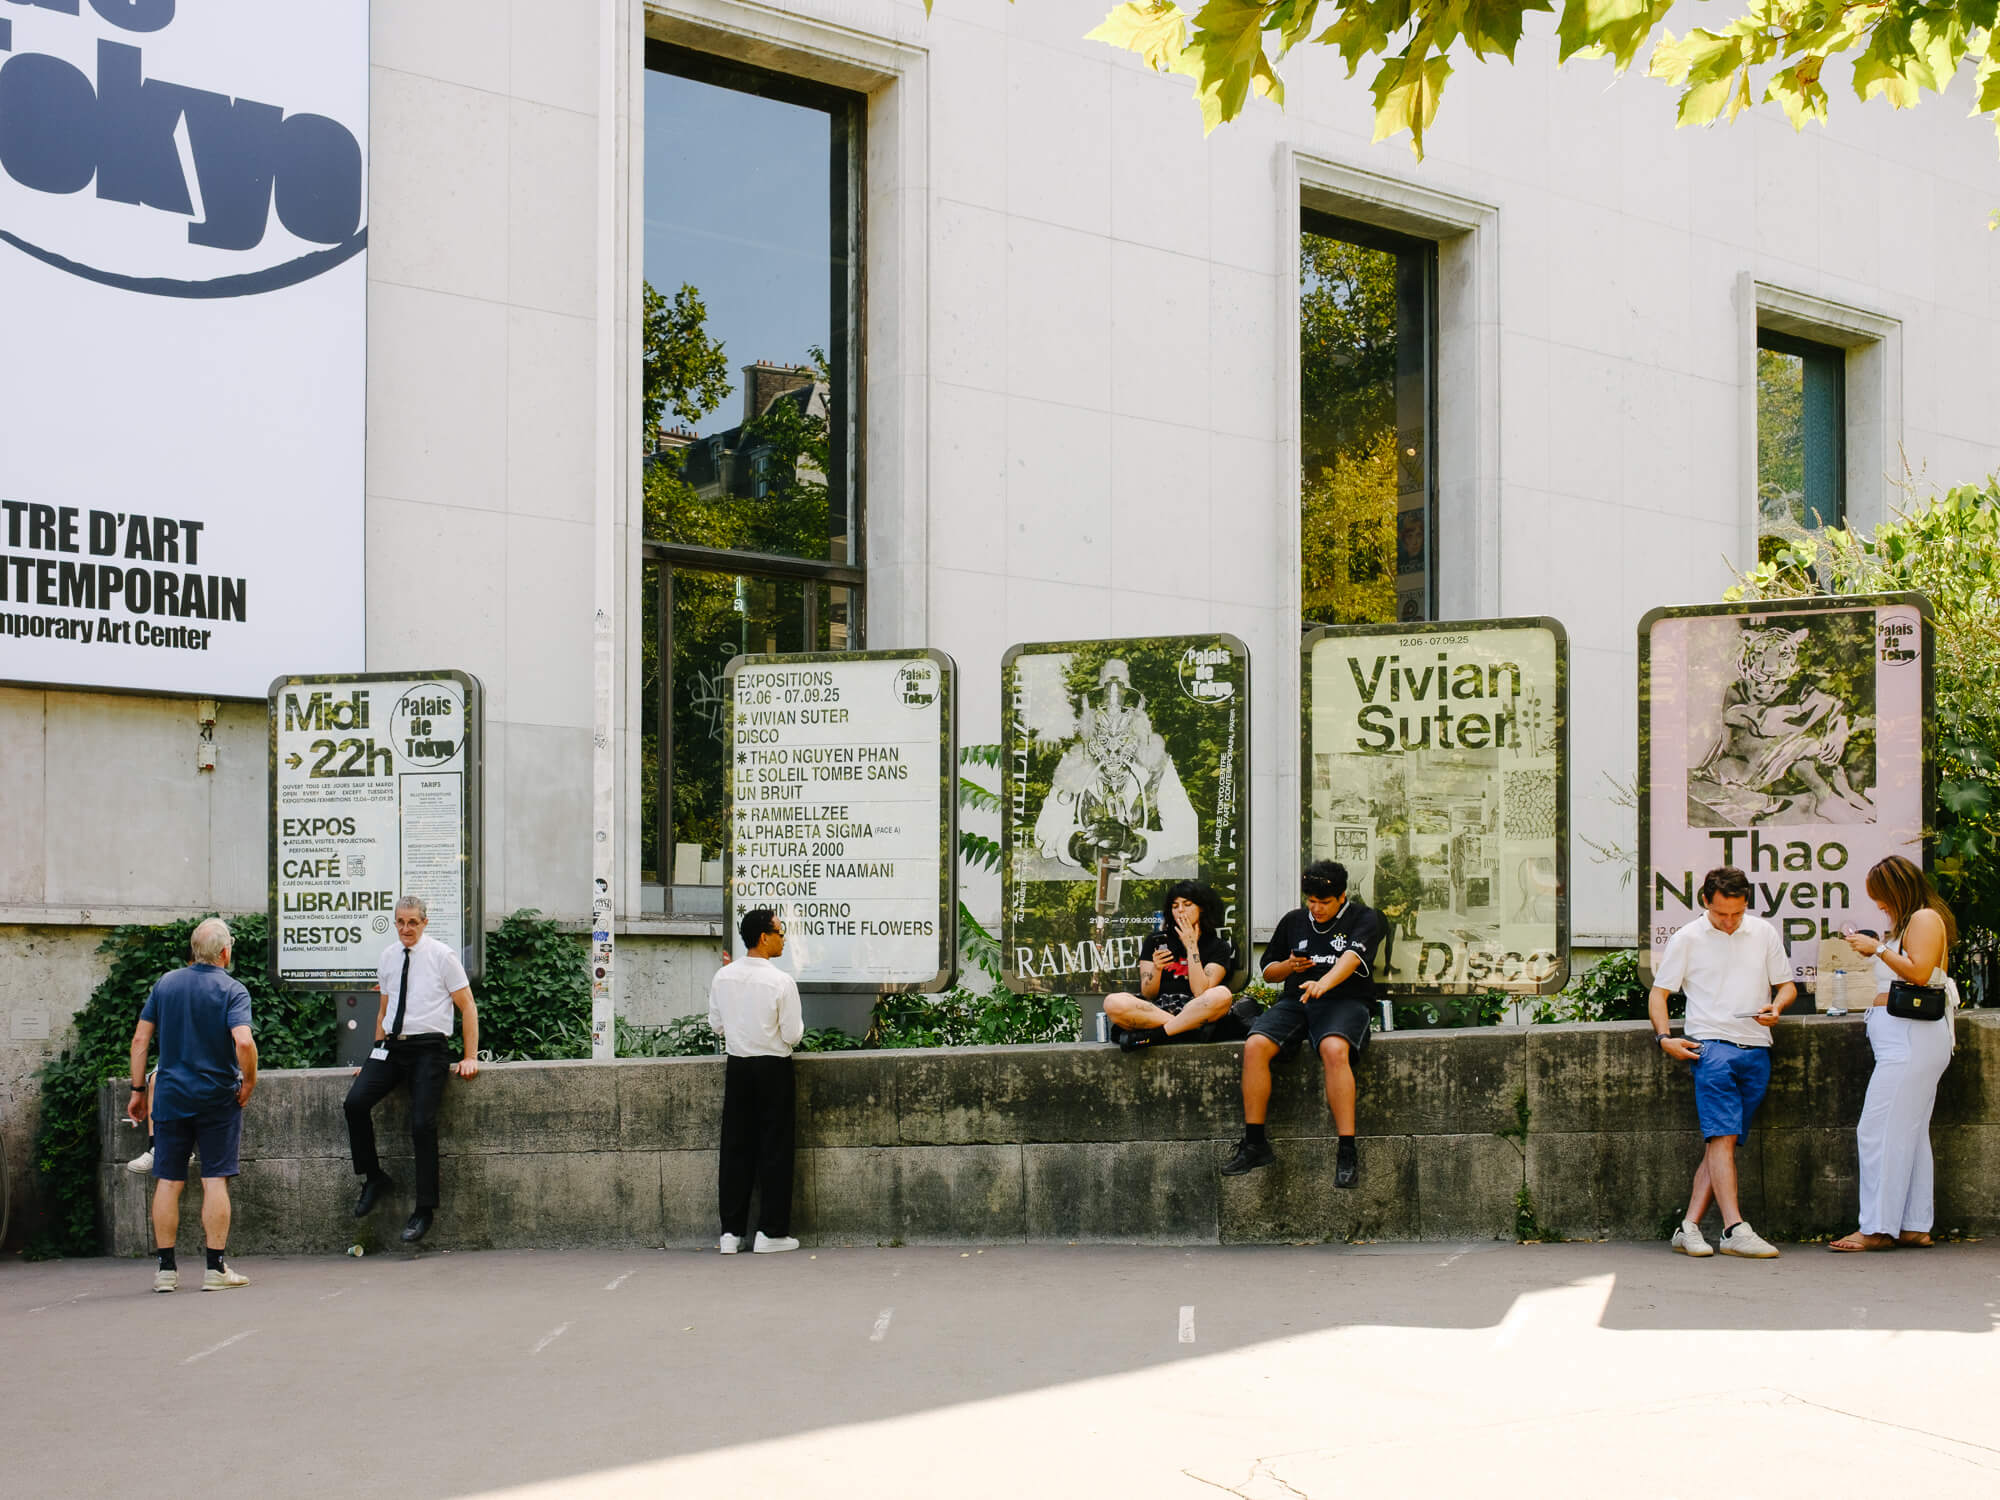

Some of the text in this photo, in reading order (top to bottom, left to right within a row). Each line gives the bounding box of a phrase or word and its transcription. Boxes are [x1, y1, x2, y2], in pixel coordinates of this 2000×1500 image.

[0, 17, 362, 251] okyo
[1, 499, 204, 565] TRE D'ART
[97, 617, 131, 644] Art
[135, 620, 211, 650] Center
[1878, 623, 1914, 637] Palais
[1400, 638, 1422, 647] 12.06
[1430, 636, 1469, 646] 07.09.25
[1884, 636, 1900, 648] de
[1188, 648, 1231, 666] Palais
[1880, 649, 1916, 662] Tokyo
[737, 671, 833, 689] EXPOSITIONS
[899, 668, 931, 681] Palais
[1195, 664, 1214, 681] de
[1347, 653, 1521, 703] Vivian
[905, 681, 919, 692] de
[1191, 680, 1233, 697] Tokyo
[738, 690, 772, 705] 12.06
[784, 688, 840, 703] 07.09.25
[902, 692, 933, 705] Tokyo
[285, 690, 370, 732] Midi
[401, 696, 451, 717] Palais
[751, 708, 849, 726] VIVIAN SUTER
[410, 717, 432, 736] de
[1356, 705, 1515, 752] Suter
[737, 729, 779, 744] DISCO
[405, 738, 455, 759] Tokyo
[751, 747, 899, 765] THAO NGUYEN PHAN
[309, 738, 393, 779] 22h
[737, 765, 908, 783] LE SOLEIL TOMBE SANS
[736, 785, 803, 801] UN BRUIT
[751, 806, 849, 822] RAMMELLZEE
[1216, 815, 1223, 828] DE
[1222, 802, 1231, 827] D'ART
[282, 817, 356, 837] EXPOS
[736, 824, 822, 840] ALPHABETA
[826, 823, 873, 838] SIGMA
[751, 842, 844, 857] FUTURA 2000
[1213, 828, 1223, 857] PALAIS
[1708, 830, 1849, 873] Thao
[282, 853, 341, 878] CAFÉ
[751, 859, 894, 879] CHALISÉE NAAMANI
[736, 881, 817, 897] OCTOGONE
[1655, 870, 1850, 918] Nyen
[283, 890, 394, 913] LIBRAIRIE
[793, 902, 851, 918] GIORNO
[283, 926, 363, 944] RESTOS
[828, 920, 856, 936] THE
[861, 920, 934, 936] FLOWERS
